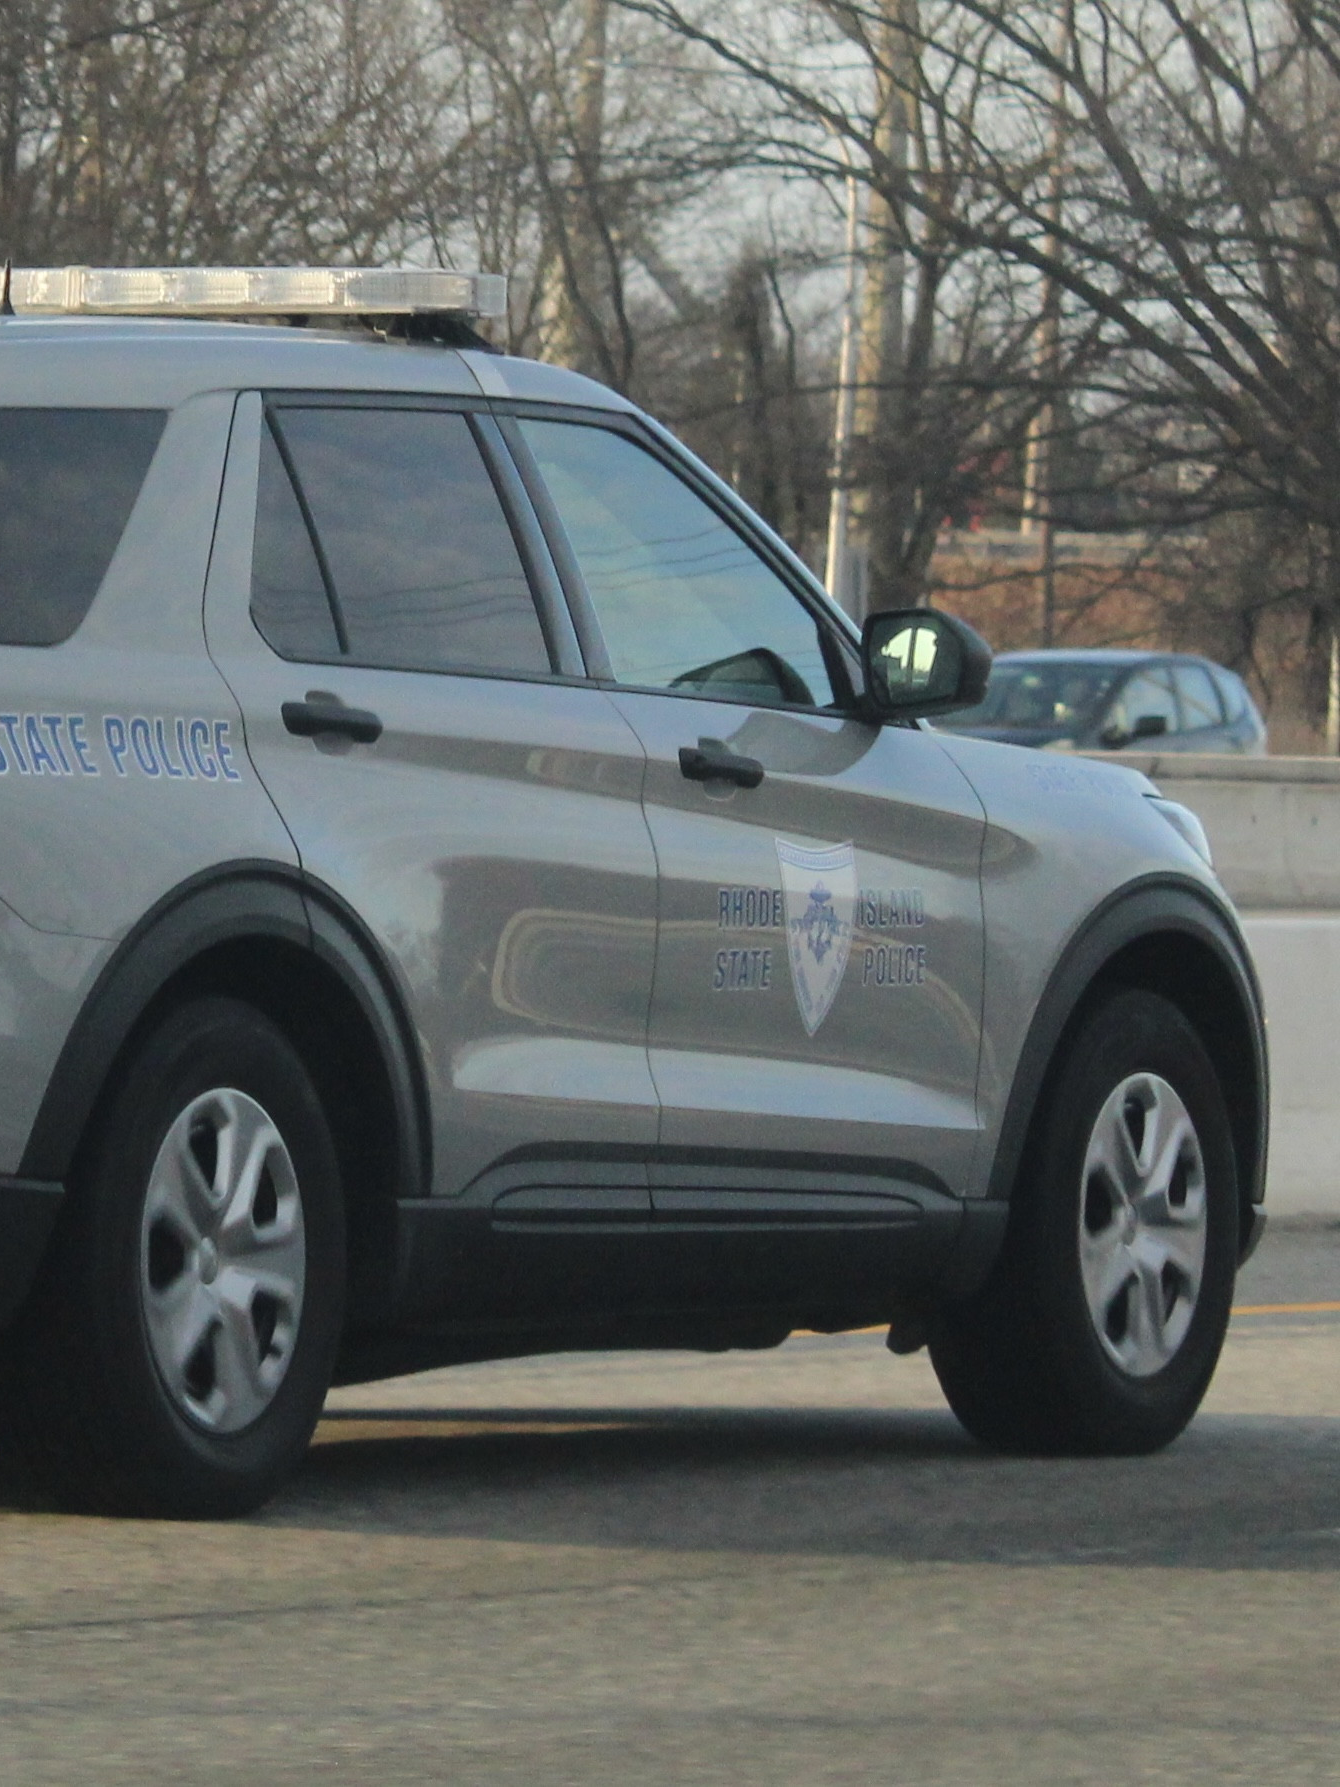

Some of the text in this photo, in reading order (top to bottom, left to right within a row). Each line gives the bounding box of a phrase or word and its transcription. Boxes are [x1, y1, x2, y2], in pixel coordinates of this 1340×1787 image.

[102, 714, 242, 783] POLICE
[718, 886, 926, 929] RHODE ISLAND
[712, 944, 927, 991] STATE POLICE
